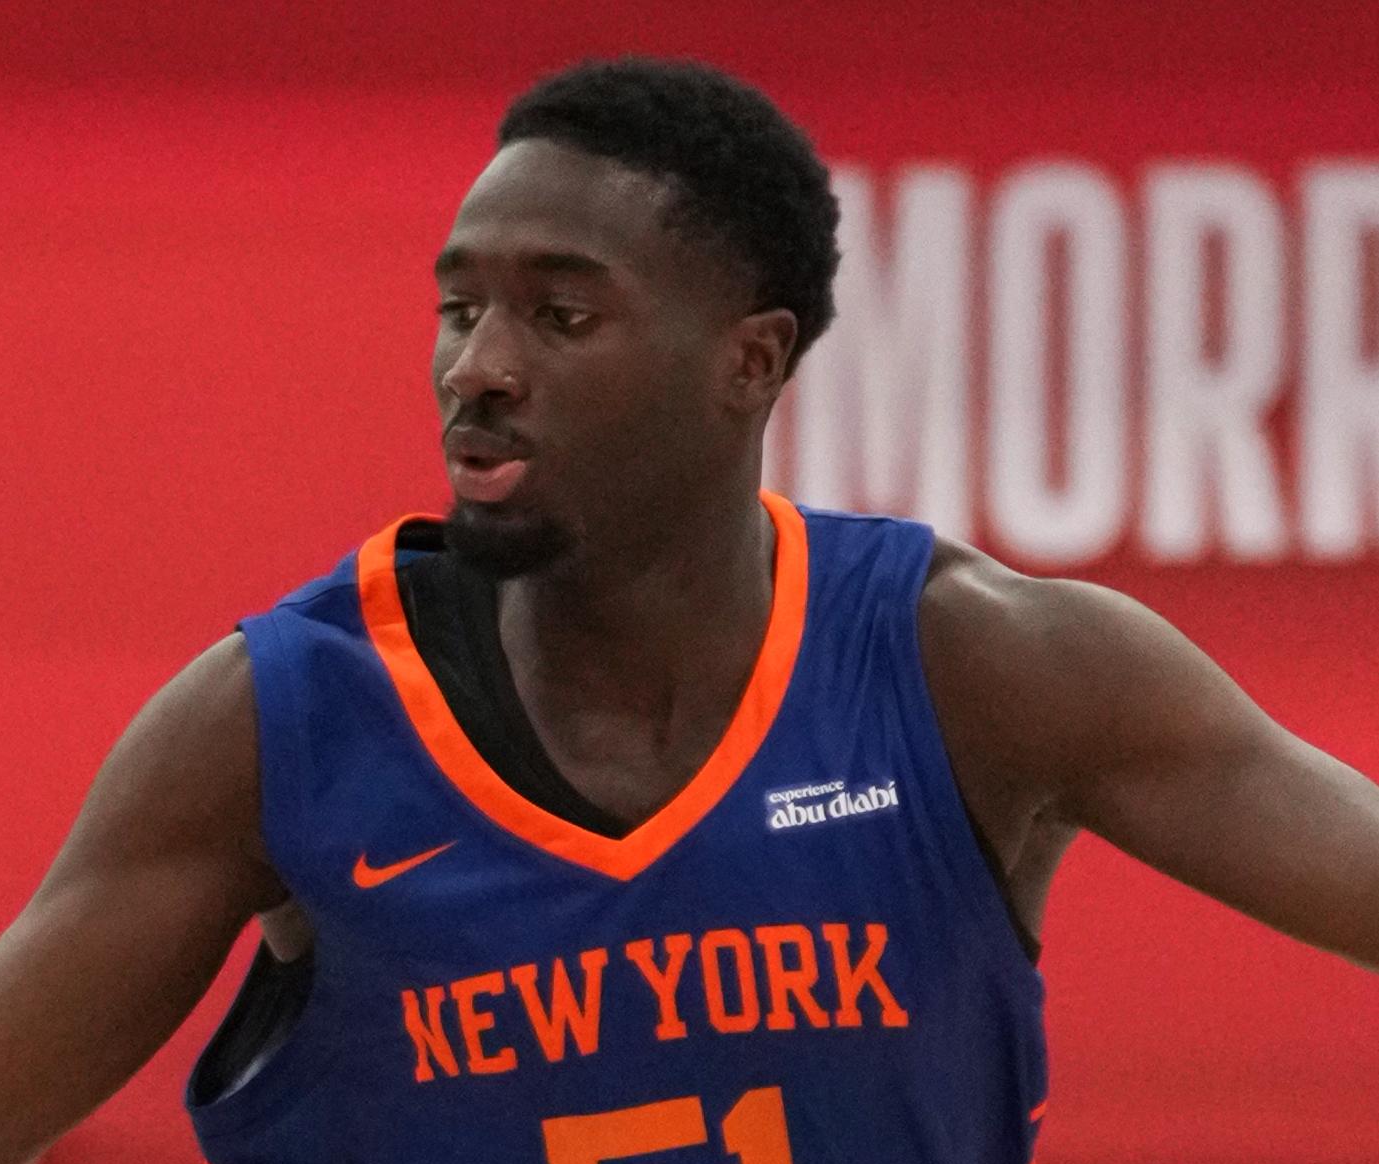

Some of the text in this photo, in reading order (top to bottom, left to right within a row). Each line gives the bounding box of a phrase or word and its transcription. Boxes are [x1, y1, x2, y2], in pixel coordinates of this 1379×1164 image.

[760, 160, 1379, 565] MORR
[768, 780, 844, 803] experience
[771, 802, 826, 829] abu
[400, 922, 909, 1083] NEW YORK
